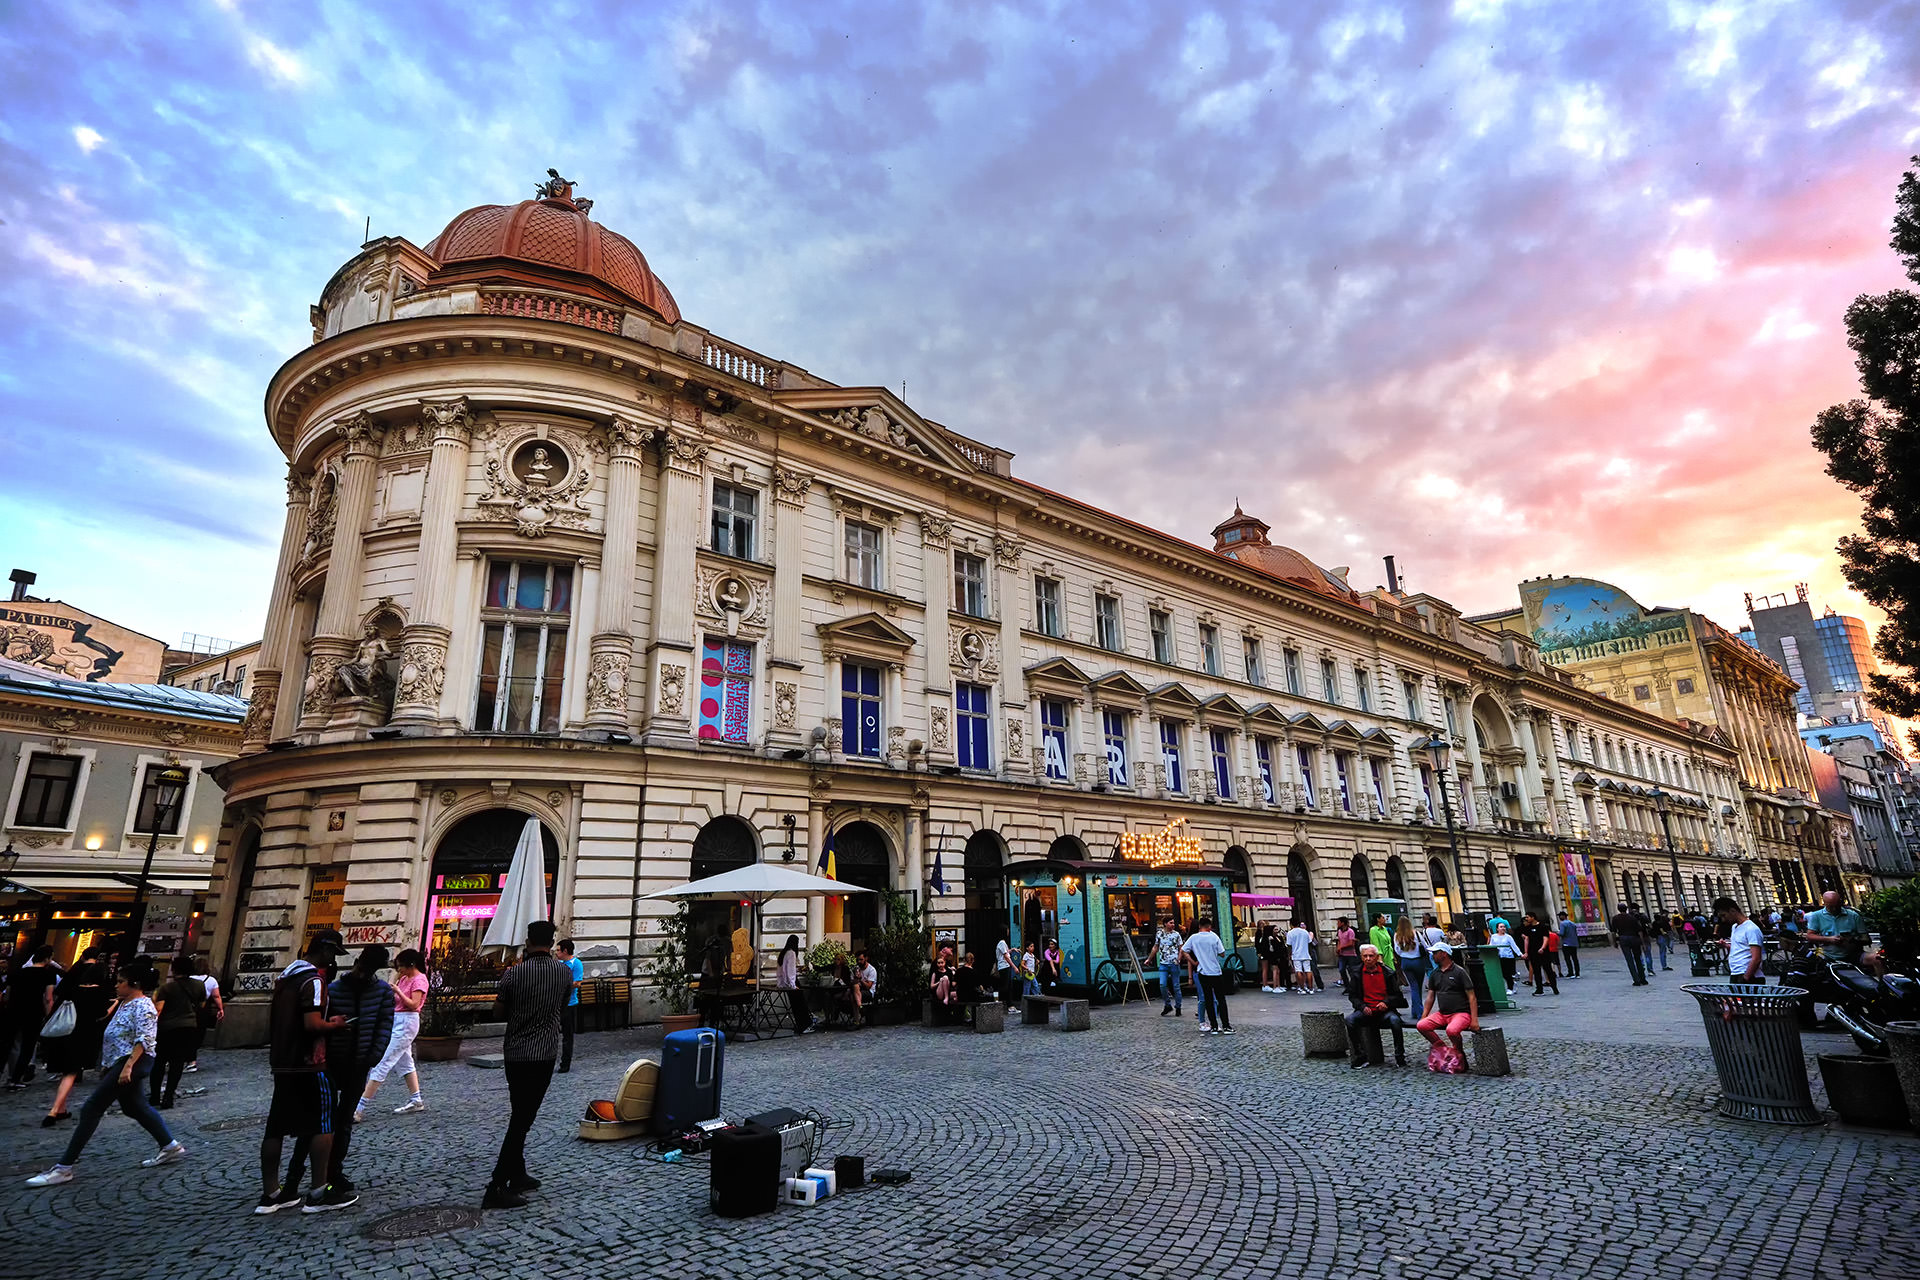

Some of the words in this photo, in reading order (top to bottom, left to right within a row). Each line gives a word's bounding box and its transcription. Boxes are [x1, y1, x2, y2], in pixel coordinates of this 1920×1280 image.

[6, 610, 76, 630] PATRICK
[441, 908, 457, 916] BOB
[461, 907, 493, 916] GEORGE
